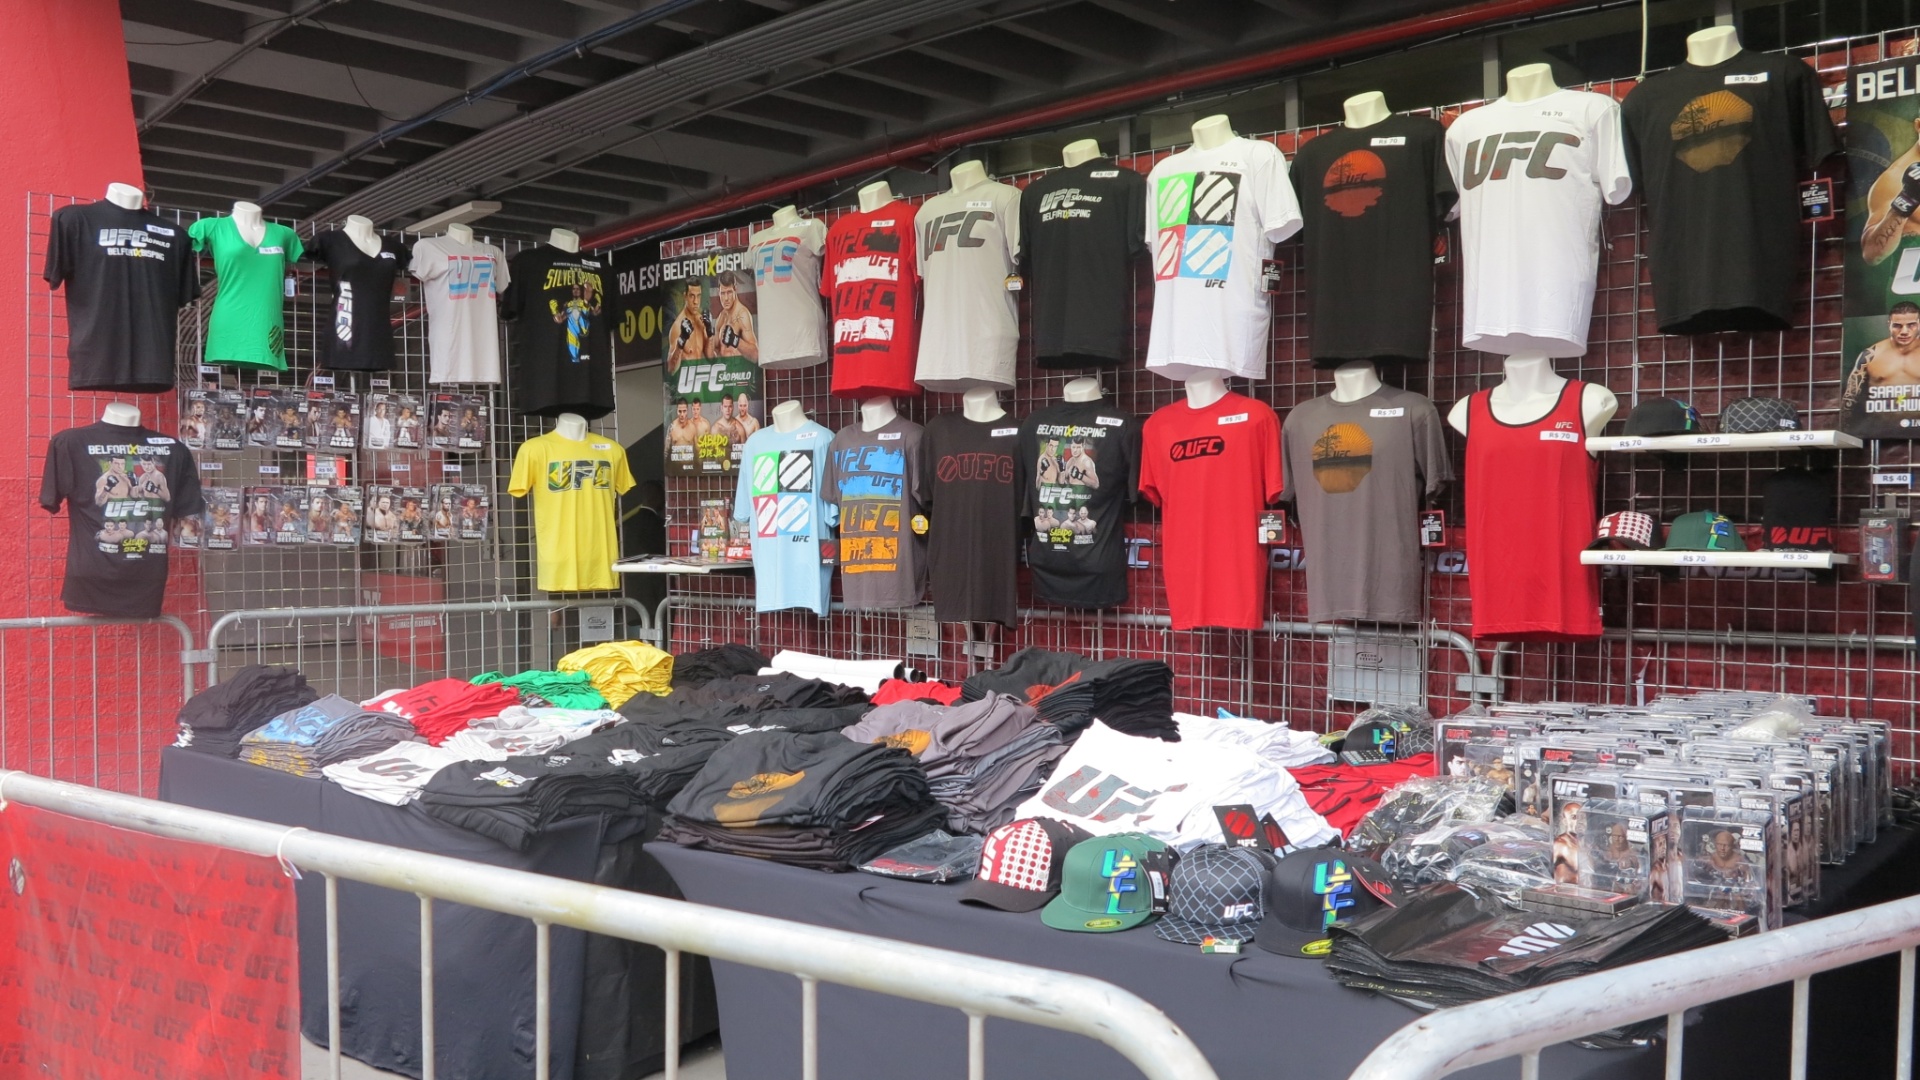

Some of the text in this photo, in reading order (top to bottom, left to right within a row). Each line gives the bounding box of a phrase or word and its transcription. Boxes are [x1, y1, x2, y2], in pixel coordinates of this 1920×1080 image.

[1462, 131, 1581, 190] UFC
[1040, 188, 1080, 214] UFC
[98, 228, 148, 247] UFC
[924, 211, 994, 262] UFC
[664, 256, 708, 282] BELFORT
[716, 252, 746, 274] BISPI
[751, 236, 801, 286] FC
[1205, 279, 1226, 289] UFC
[678, 363, 727, 394] UFC
[731, 370, 752, 380] PAULO
[1036, 424, 1067, 436] BELFORT
[1073, 426, 1107, 437] BISPING
[1780, 419, 1796, 429] UFC
[88, 444, 130, 455] BELFORT
[137, 445, 171, 456] BISPING
[1185, 438, 1222, 458] UFC
[1333, 450, 1350, 458] UFC
[548, 460, 612, 492] UFC
[957, 453, 1014, 484] UFC
[1883, 474, 1908, 482] R$ 40
[1039, 486, 1073, 504] UFC
[104, 500, 149, 518] UFC
[841, 504, 900, 534] UFC
[1868, 519, 1888, 528] UFC
[792, 535, 810, 544] UFC
[1788, 528, 1832, 544] UF
[1554, 780, 1590, 798] UFC
[1740, 801, 1771, 810] SILVA
[1628, 819, 1646, 830] UFC
[1742, 827, 1762, 839] UFC
[1236, 838, 1258, 848] UFC
[980, 825, 1015, 880] UFC
[1224, 903, 1254, 918] UFC
[245, 955, 291, 984] UFC
